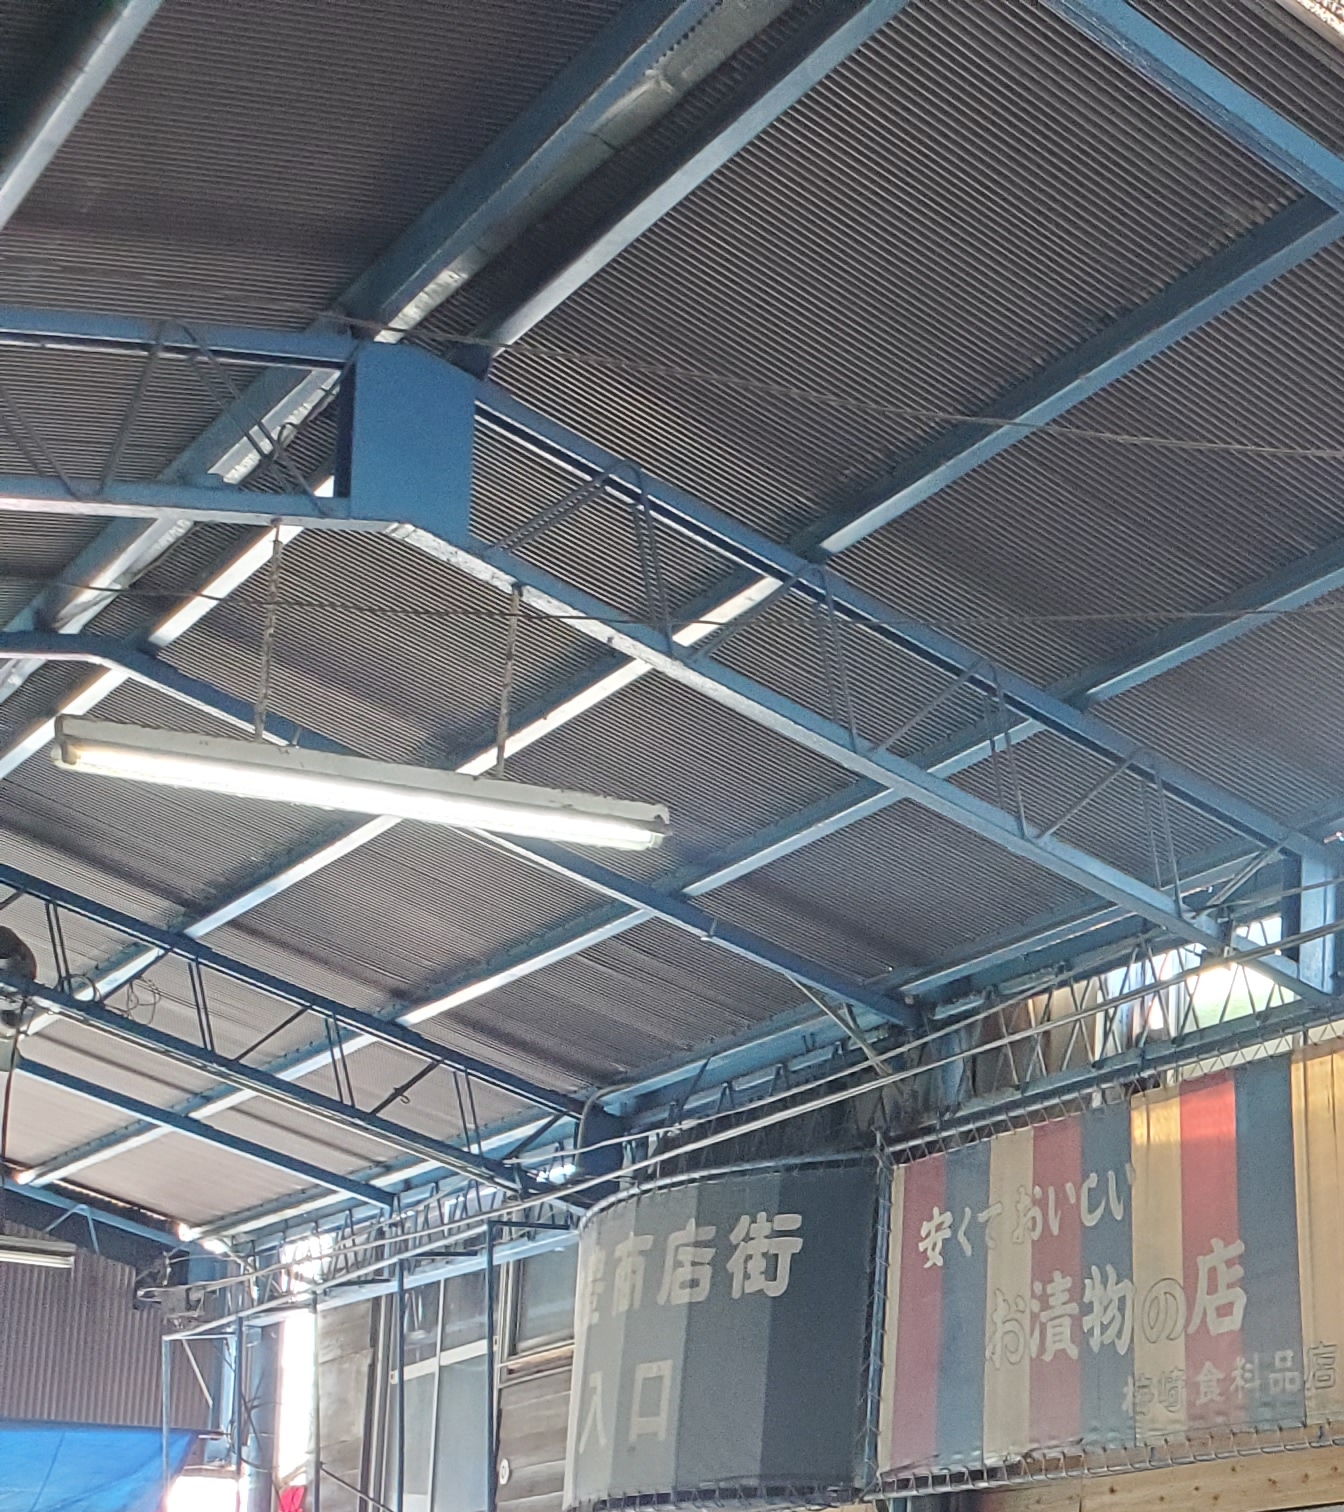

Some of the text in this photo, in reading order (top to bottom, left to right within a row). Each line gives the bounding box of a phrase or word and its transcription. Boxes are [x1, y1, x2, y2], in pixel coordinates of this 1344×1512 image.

[918, 1161, 1137, 1269] 安くておいしい
[984, 1237, 1248, 1371] お漬物の店
[579, 1359, 674, 1454] 入口
